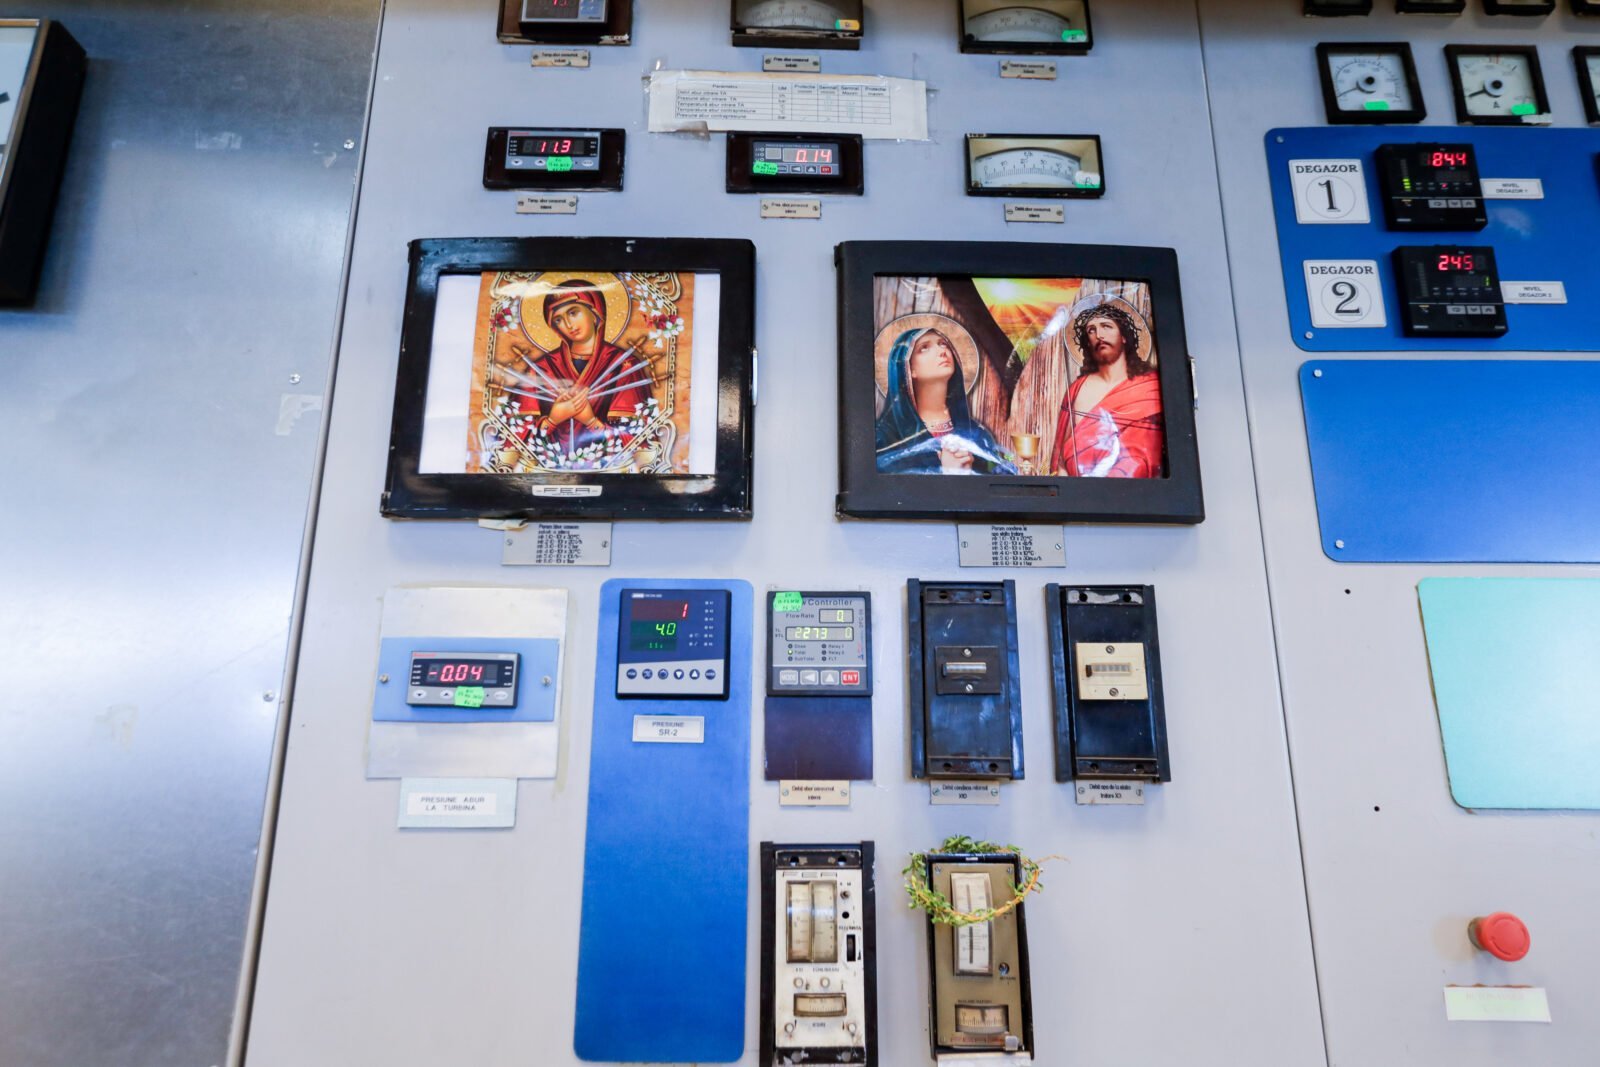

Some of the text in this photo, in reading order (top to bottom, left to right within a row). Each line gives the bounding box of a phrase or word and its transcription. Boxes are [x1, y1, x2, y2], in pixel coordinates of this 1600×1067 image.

[1432, 152, 1467, 167] 844
[1295, 164, 1359, 174] DEGAZOR
[1318, 179, 1340, 211] 1
[1310, 265, 1374, 275] DEGAZOR
[1438, 255, 1474, 271] 245
[1331, 281, 1361, 315] 2
[807, 598, 853, 606] Controller
[794, 627, 828, 640] 2273
